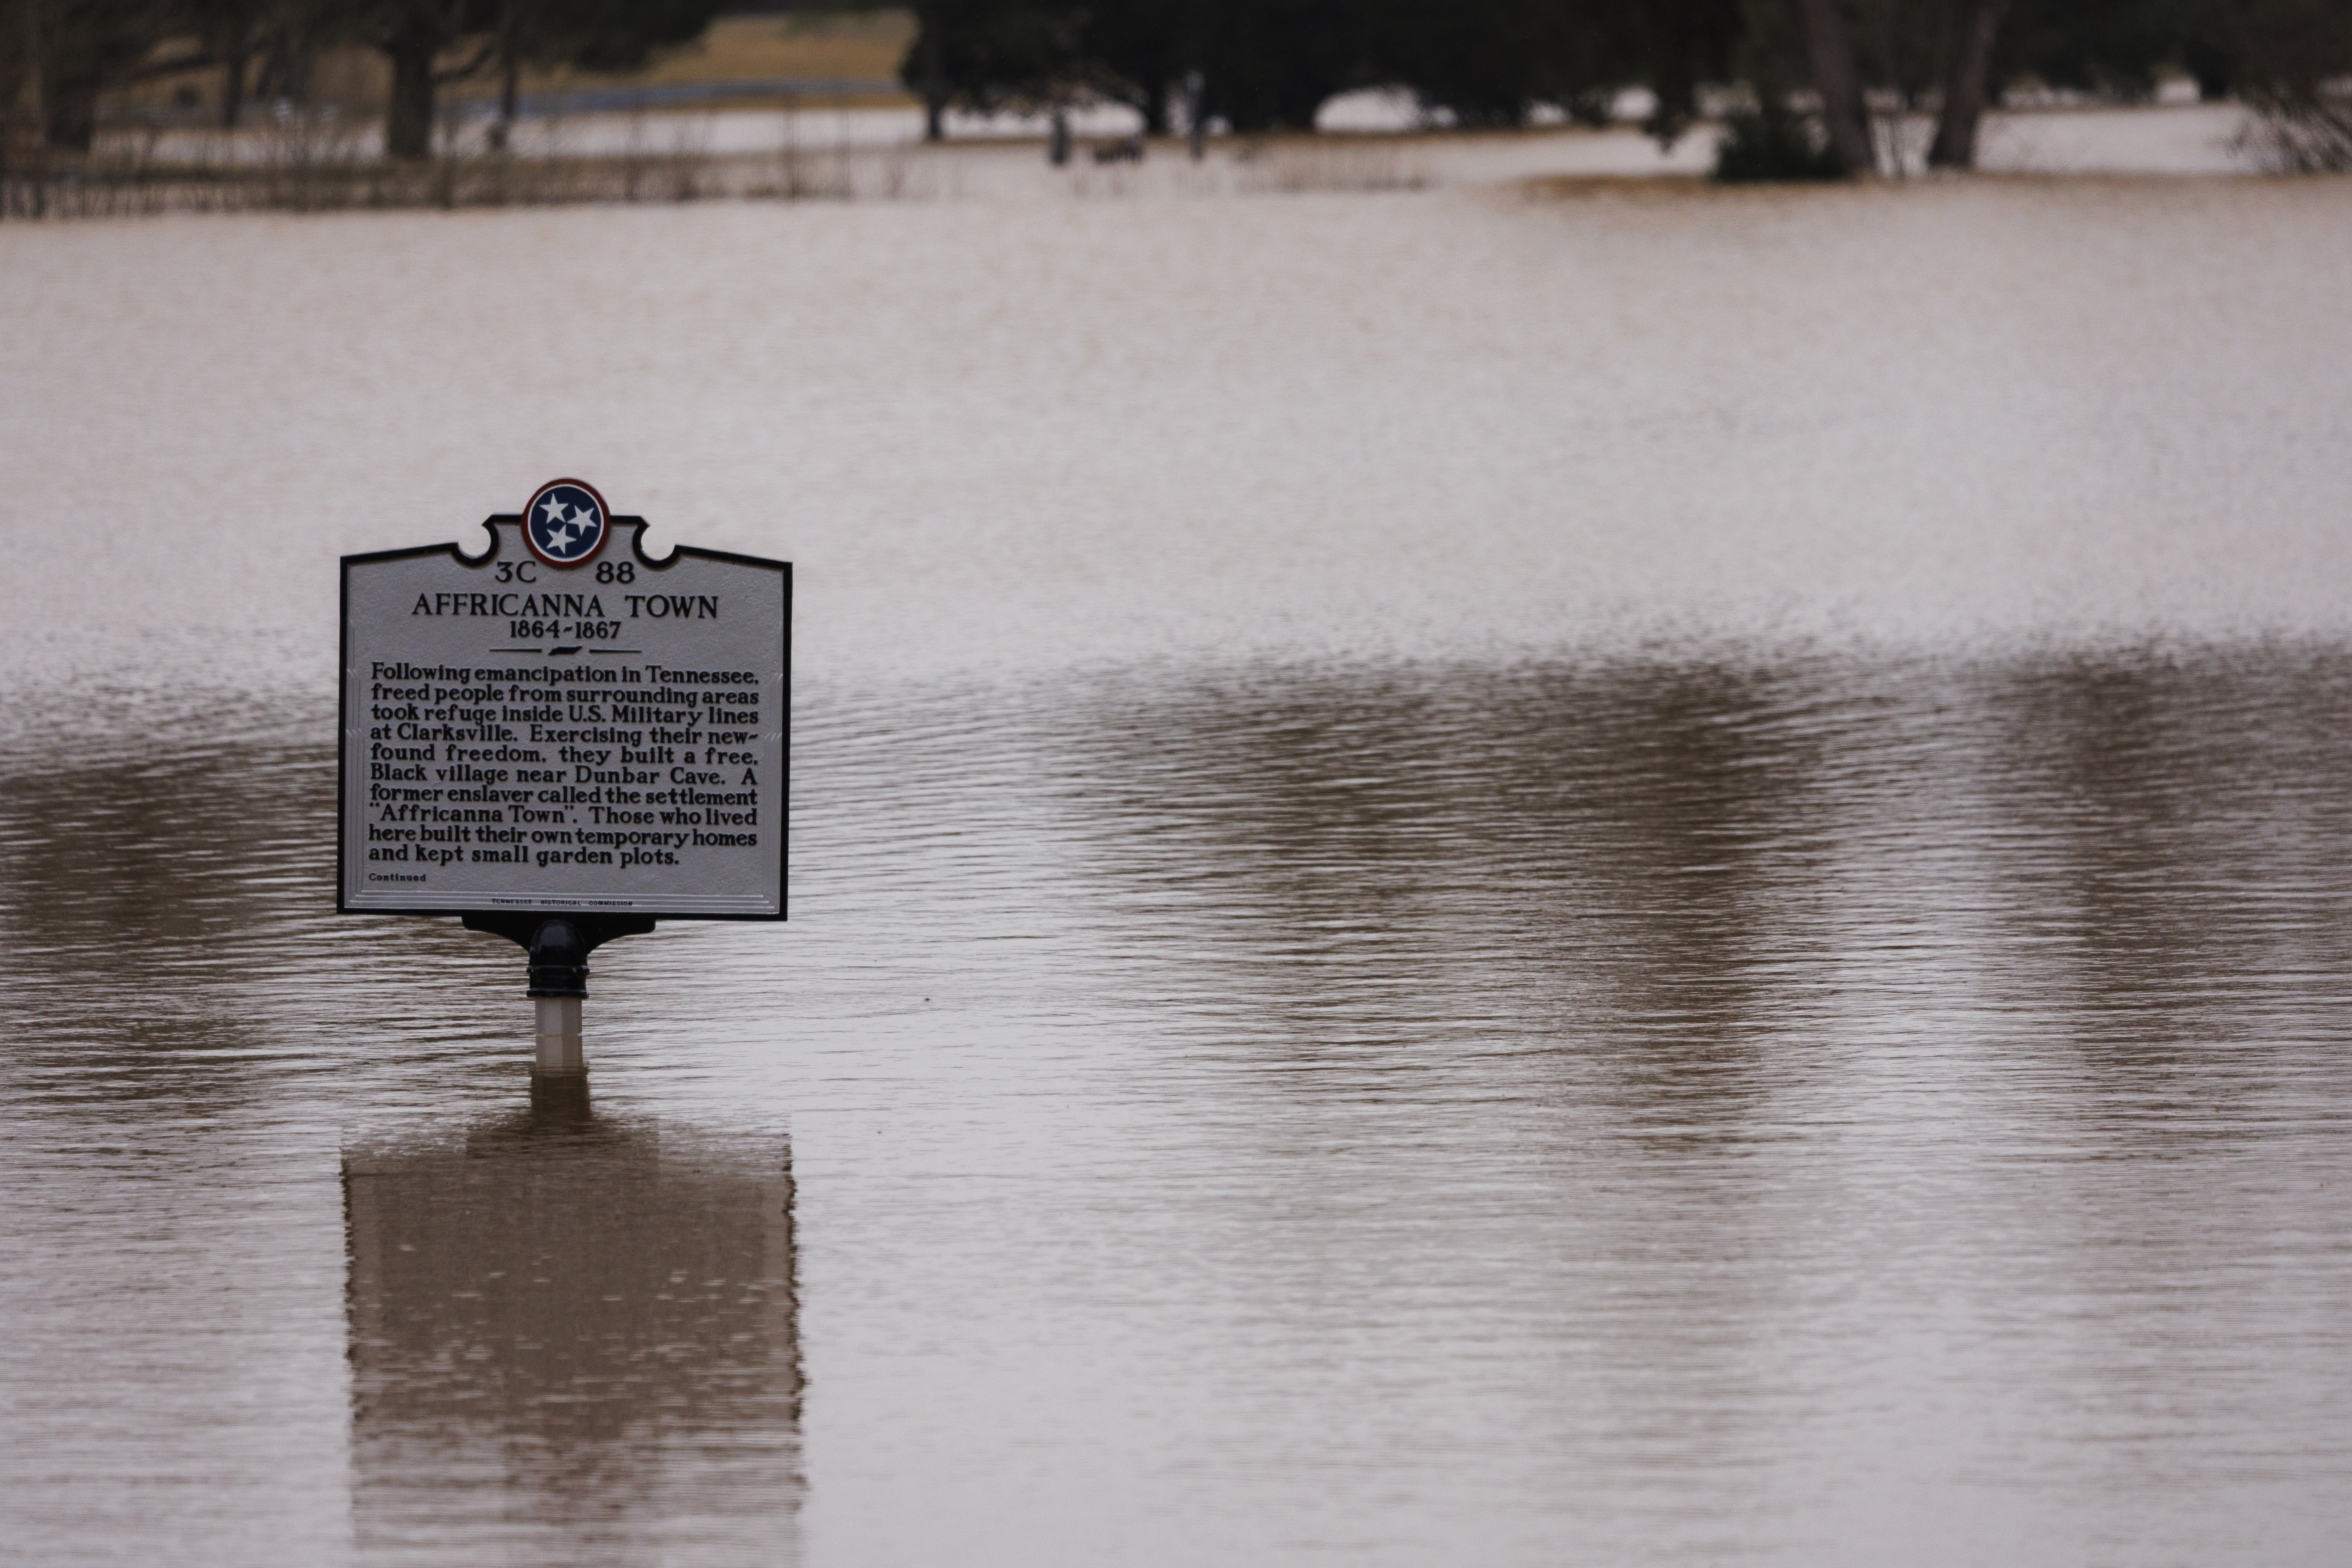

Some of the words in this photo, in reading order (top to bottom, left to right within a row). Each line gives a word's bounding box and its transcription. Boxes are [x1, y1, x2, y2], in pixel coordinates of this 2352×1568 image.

[495, 560, 537, 584] 3C
[595, 561, 635, 585] 88
[411, 593, 605, 618] AFFRICANNA
[624, 594, 719, 619] TOWN
[371, 662, 471, 685] Following
[474, 665, 617, 687] emancipation
[622, 666, 641, 683] in
[645, 665, 759, 685] Tennessee,
[371, 682, 430, 701] freed
[434, 683, 504, 706] people
[508, 684, 563, 702] from
[566, 686, 698, 709] surrounding
[702, 691, 759, 705] areas
[371, 702, 420, 720] took
[424, 704, 497, 725] refuge
[502, 704, 563, 722] inside
[569, 704, 606, 723] U.S.
[612, 704, 703, 727] Military
[708, 706, 759, 724] lines
[370, 723, 392, 740] at
[397, 722, 518, 742] Clarksville.
[530, 724, 642, 748] Exercising
[649, 727, 703, 744] their
[370, 742, 436, 761] found
[445, 743, 546, 763] freedom,
[558, 746, 612, 766] they
[620, 745, 674, 764] built
[684, 751, 696, 764] a
[705, 747, 758, 766] free,
[370, 762, 428, 781] Black
[435, 764, 508, 785] village
[516, 769, 567, 783] near
[575, 765, 660, 784] Dunbar
[670, 766, 726, 785] Cave.
[740, 767, 758, 786] A
[369, 782, 444, 802] former
[447, 784, 534, 803] enslaver
[537, 786, 602, 804] called
[604, 786, 641, 804] the
[646, 787, 758, 806] settlement
[588, 806, 654, 825] Those
[659, 807, 702, 825] who
[705, 808, 757, 826] lived
[368, 823, 417, 842] here
[420, 824, 471, 843] built
[475, 824, 528, 843] their
[531, 831, 573, 844] own
[575, 828, 690, 850] temporary
[692, 828, 757, 847] homes
[368, 844, 409, 862] and
[415, 844, 464, 867] kept
[472, 844, 529, 863] small
[536, 846, 613, 868] garden
[620, 847, 679, 869] plots.
[368, 873, 426, 882] Continued
